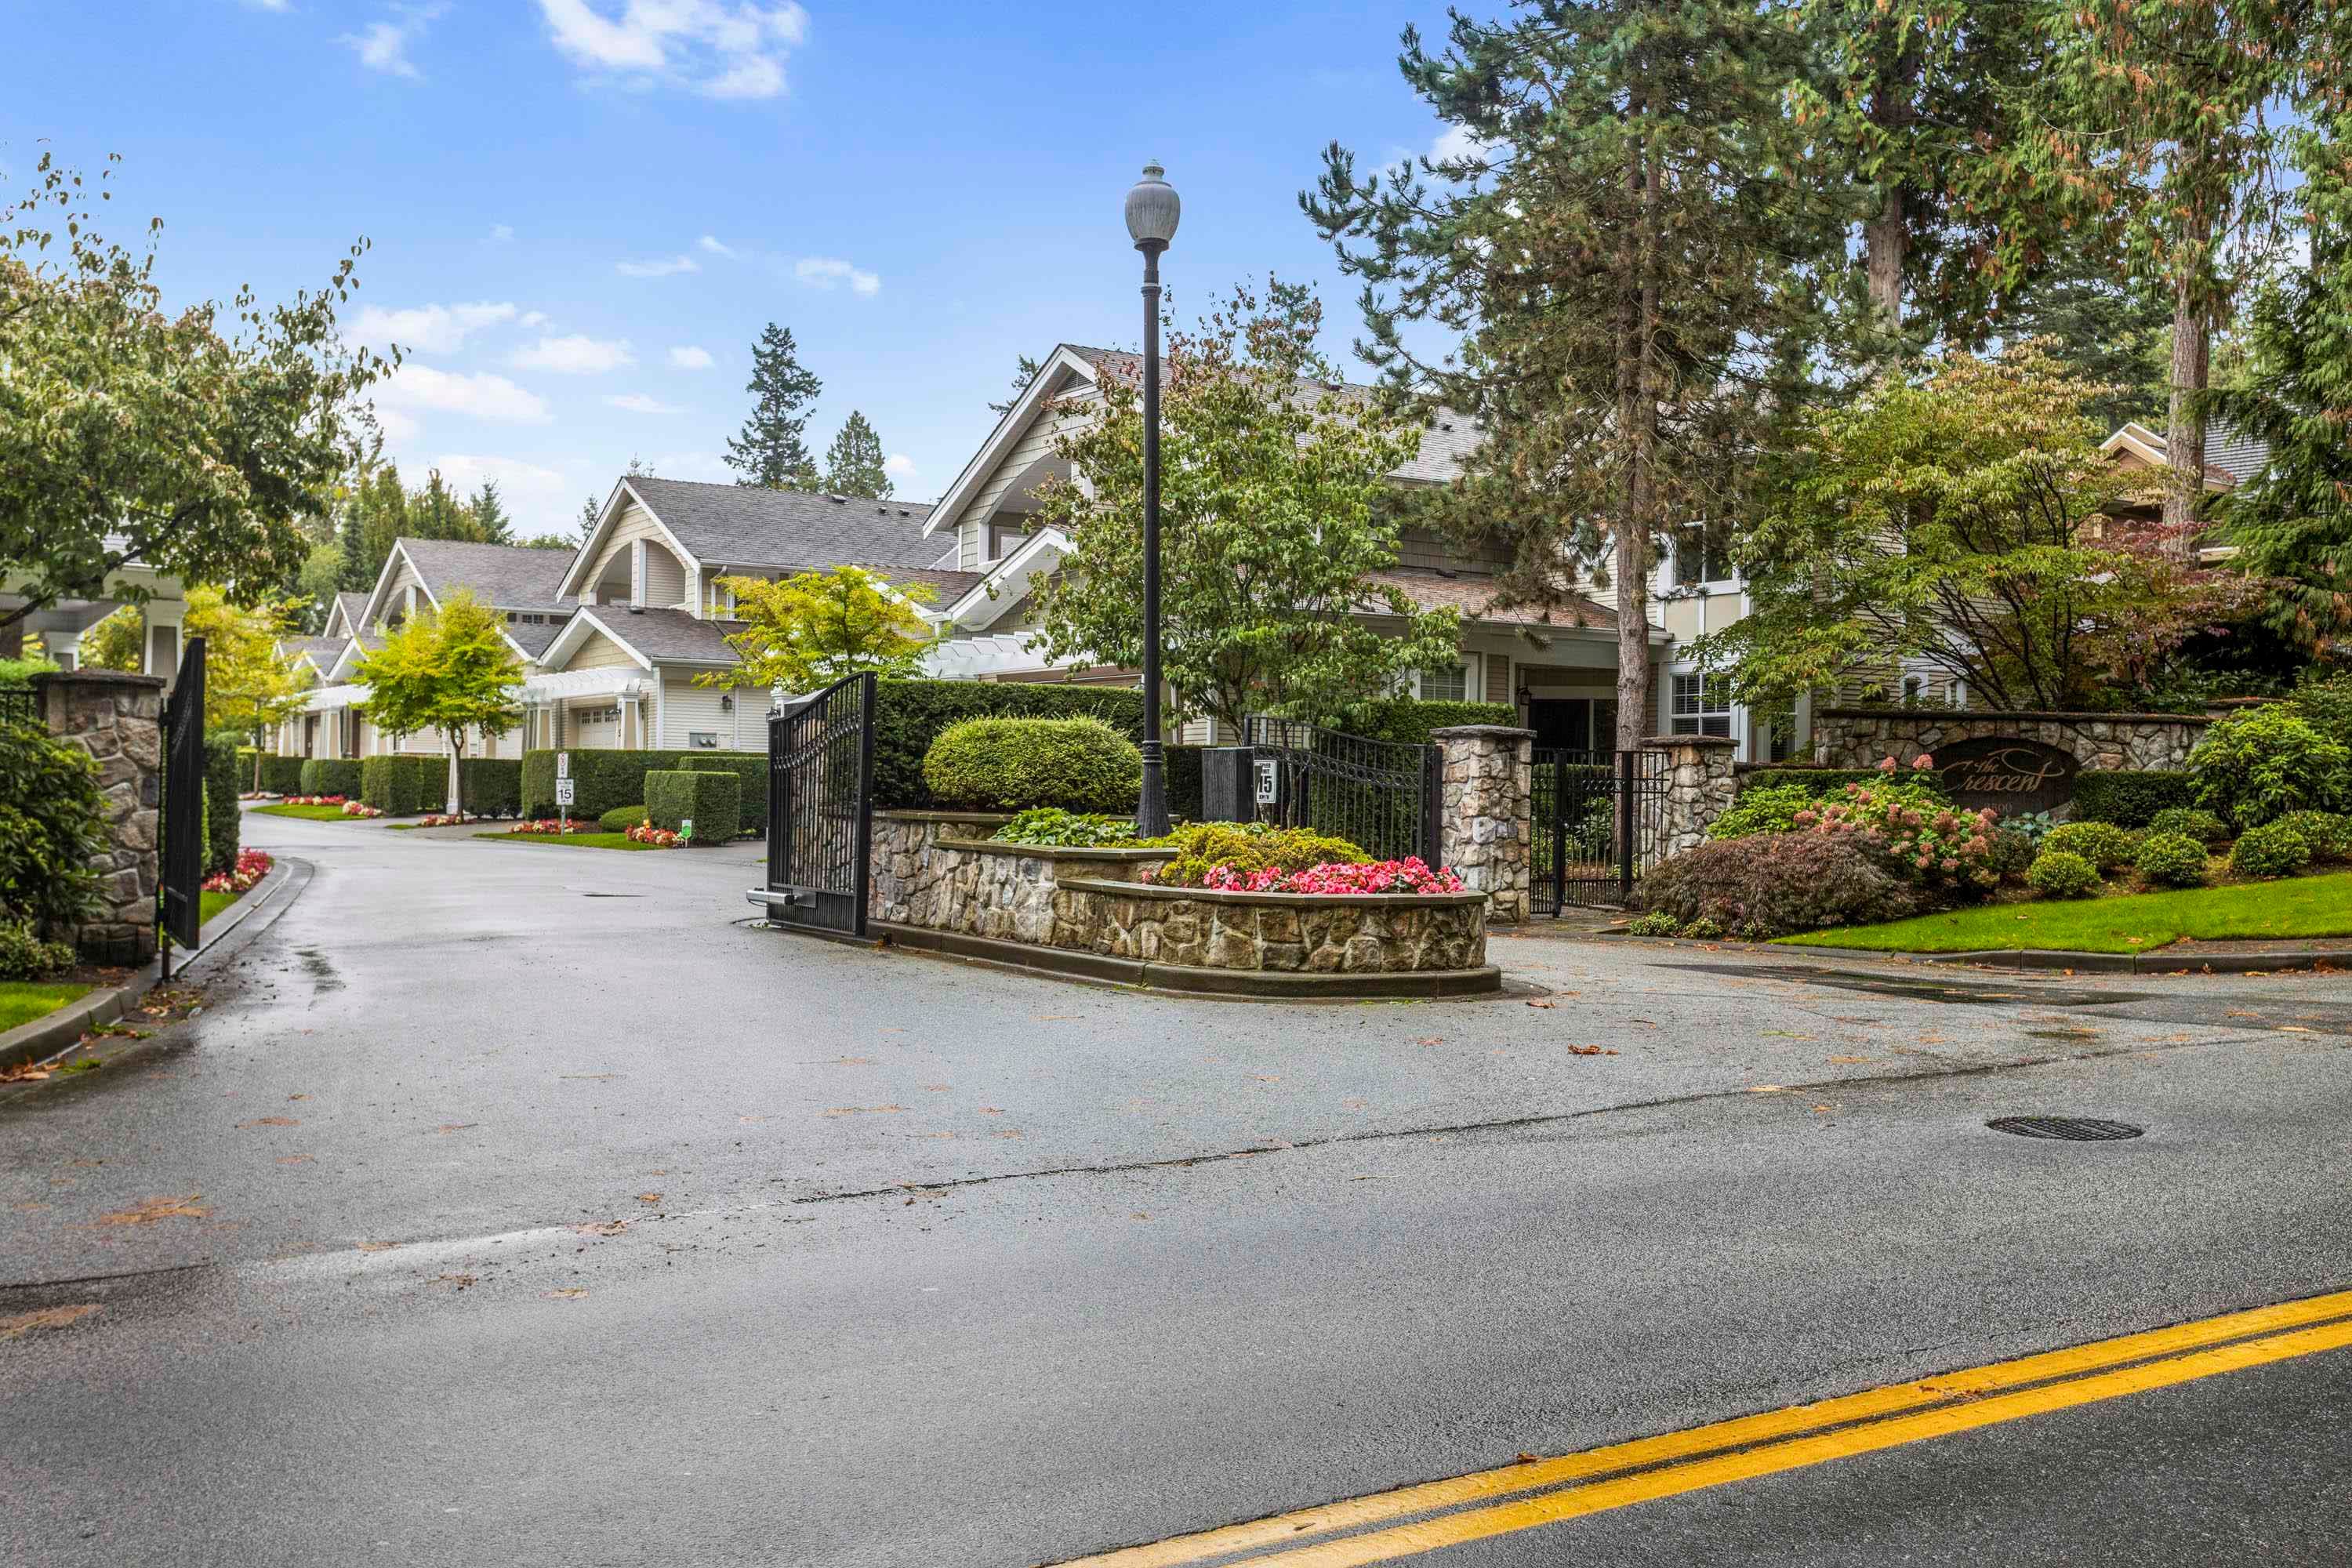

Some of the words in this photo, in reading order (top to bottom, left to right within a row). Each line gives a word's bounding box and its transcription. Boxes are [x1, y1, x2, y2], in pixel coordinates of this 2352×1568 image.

[1943, 749, 2065, 793] Crescent
[1259, 775, 1272, 793] 15
[558, 789, 572, 799] 15
